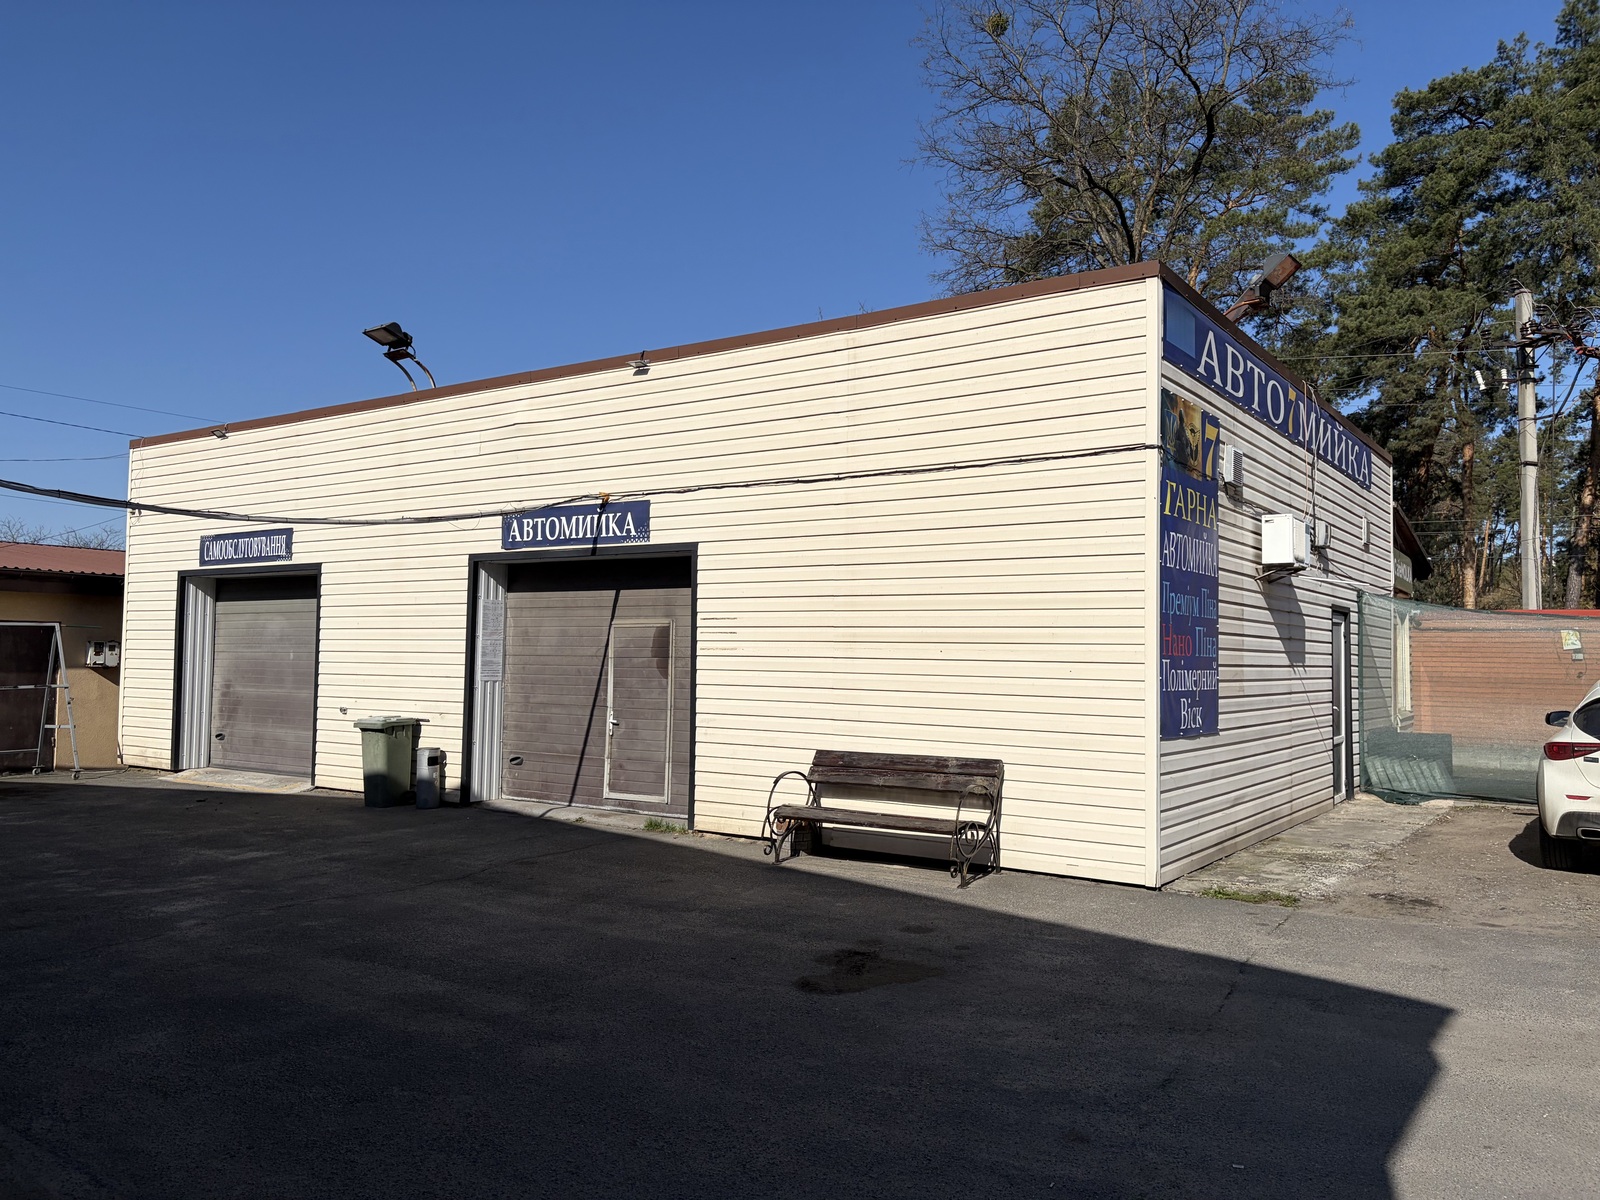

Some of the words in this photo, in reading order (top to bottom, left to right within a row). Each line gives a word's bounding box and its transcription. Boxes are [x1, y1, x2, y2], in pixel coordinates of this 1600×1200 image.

[1163, 480, 1217, 530] ГАРНА
[1162, 530, 1218, 577] АВТОМИЙКА
[1162, 581, 1199, 625] Преміум
[1201, 588, 1217, 620] Піна
[1162, 623, 1193, 657] Нано
[1195, 626, 1217, 657] Піна
[1162, 659, 1217, 700] Полімерний
[1180, 698, 1202, 730] Віск
